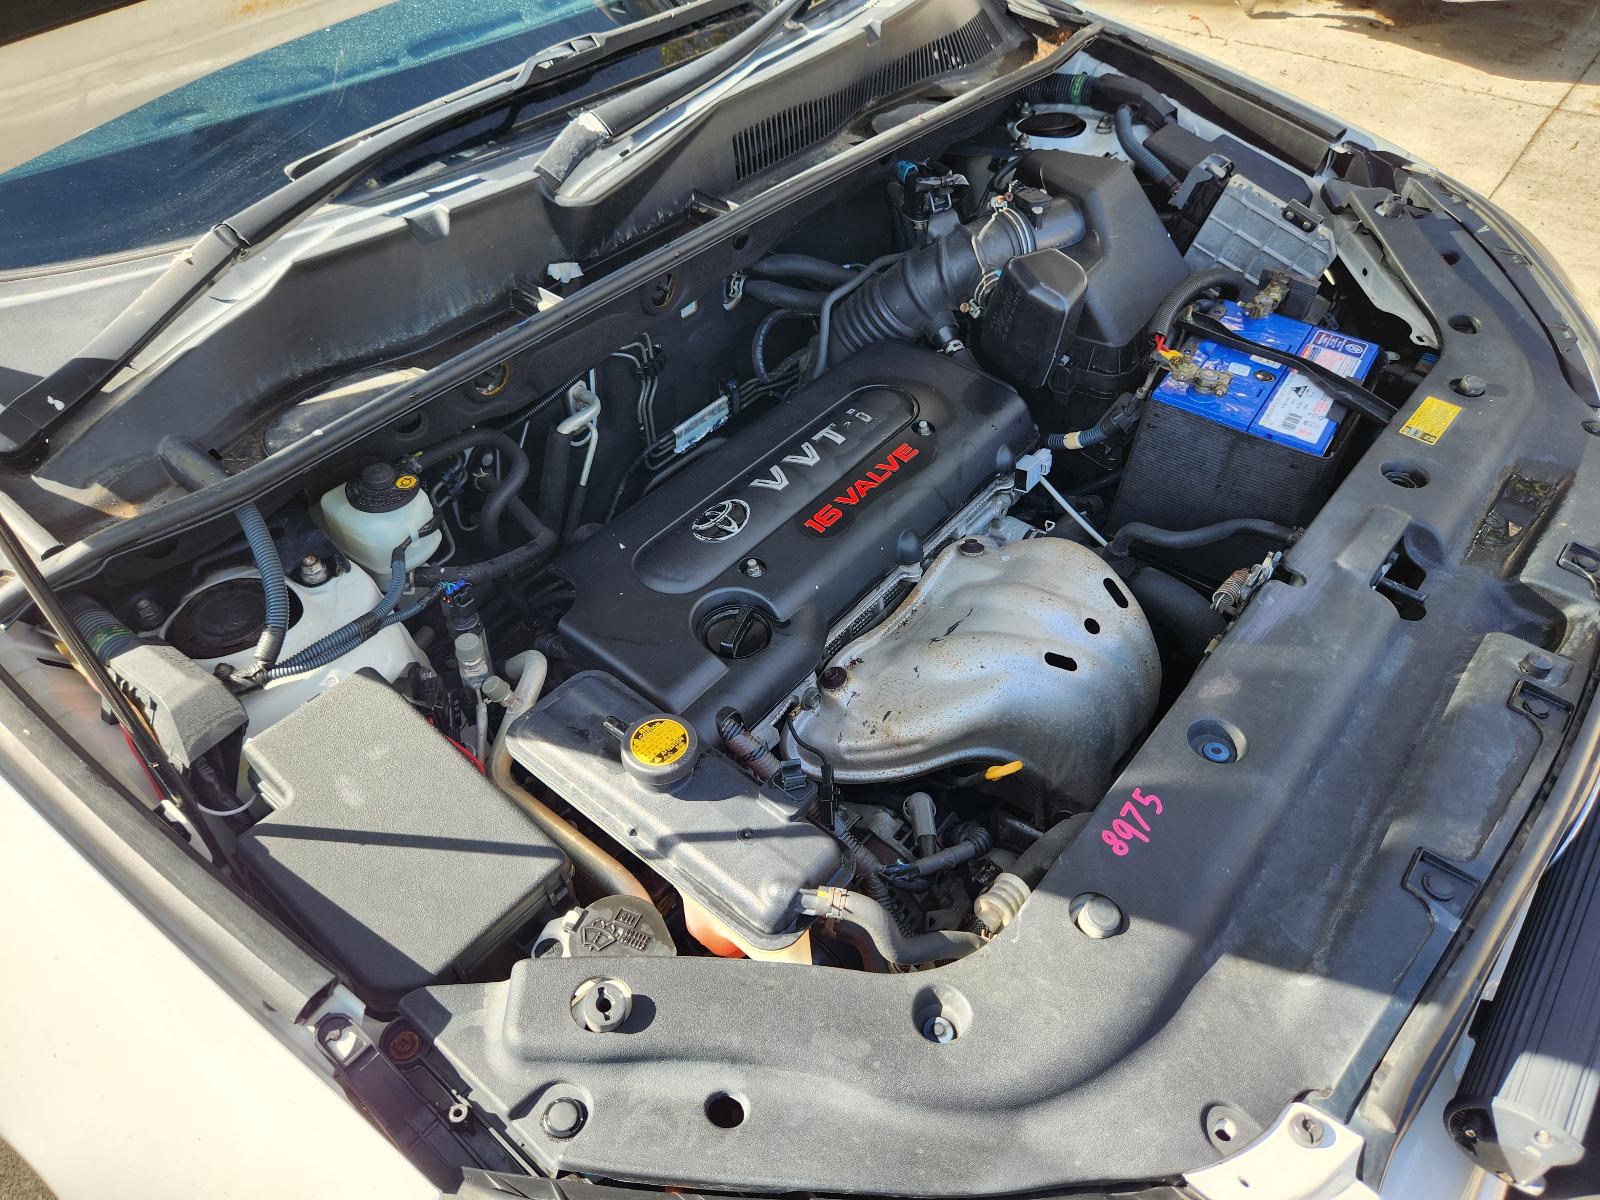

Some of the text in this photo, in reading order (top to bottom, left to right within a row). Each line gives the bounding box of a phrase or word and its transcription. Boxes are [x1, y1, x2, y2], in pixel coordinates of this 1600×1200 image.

[803, 442, 920, 534] 16 VALVE
[1101, 787, 1163, 857] 8975
